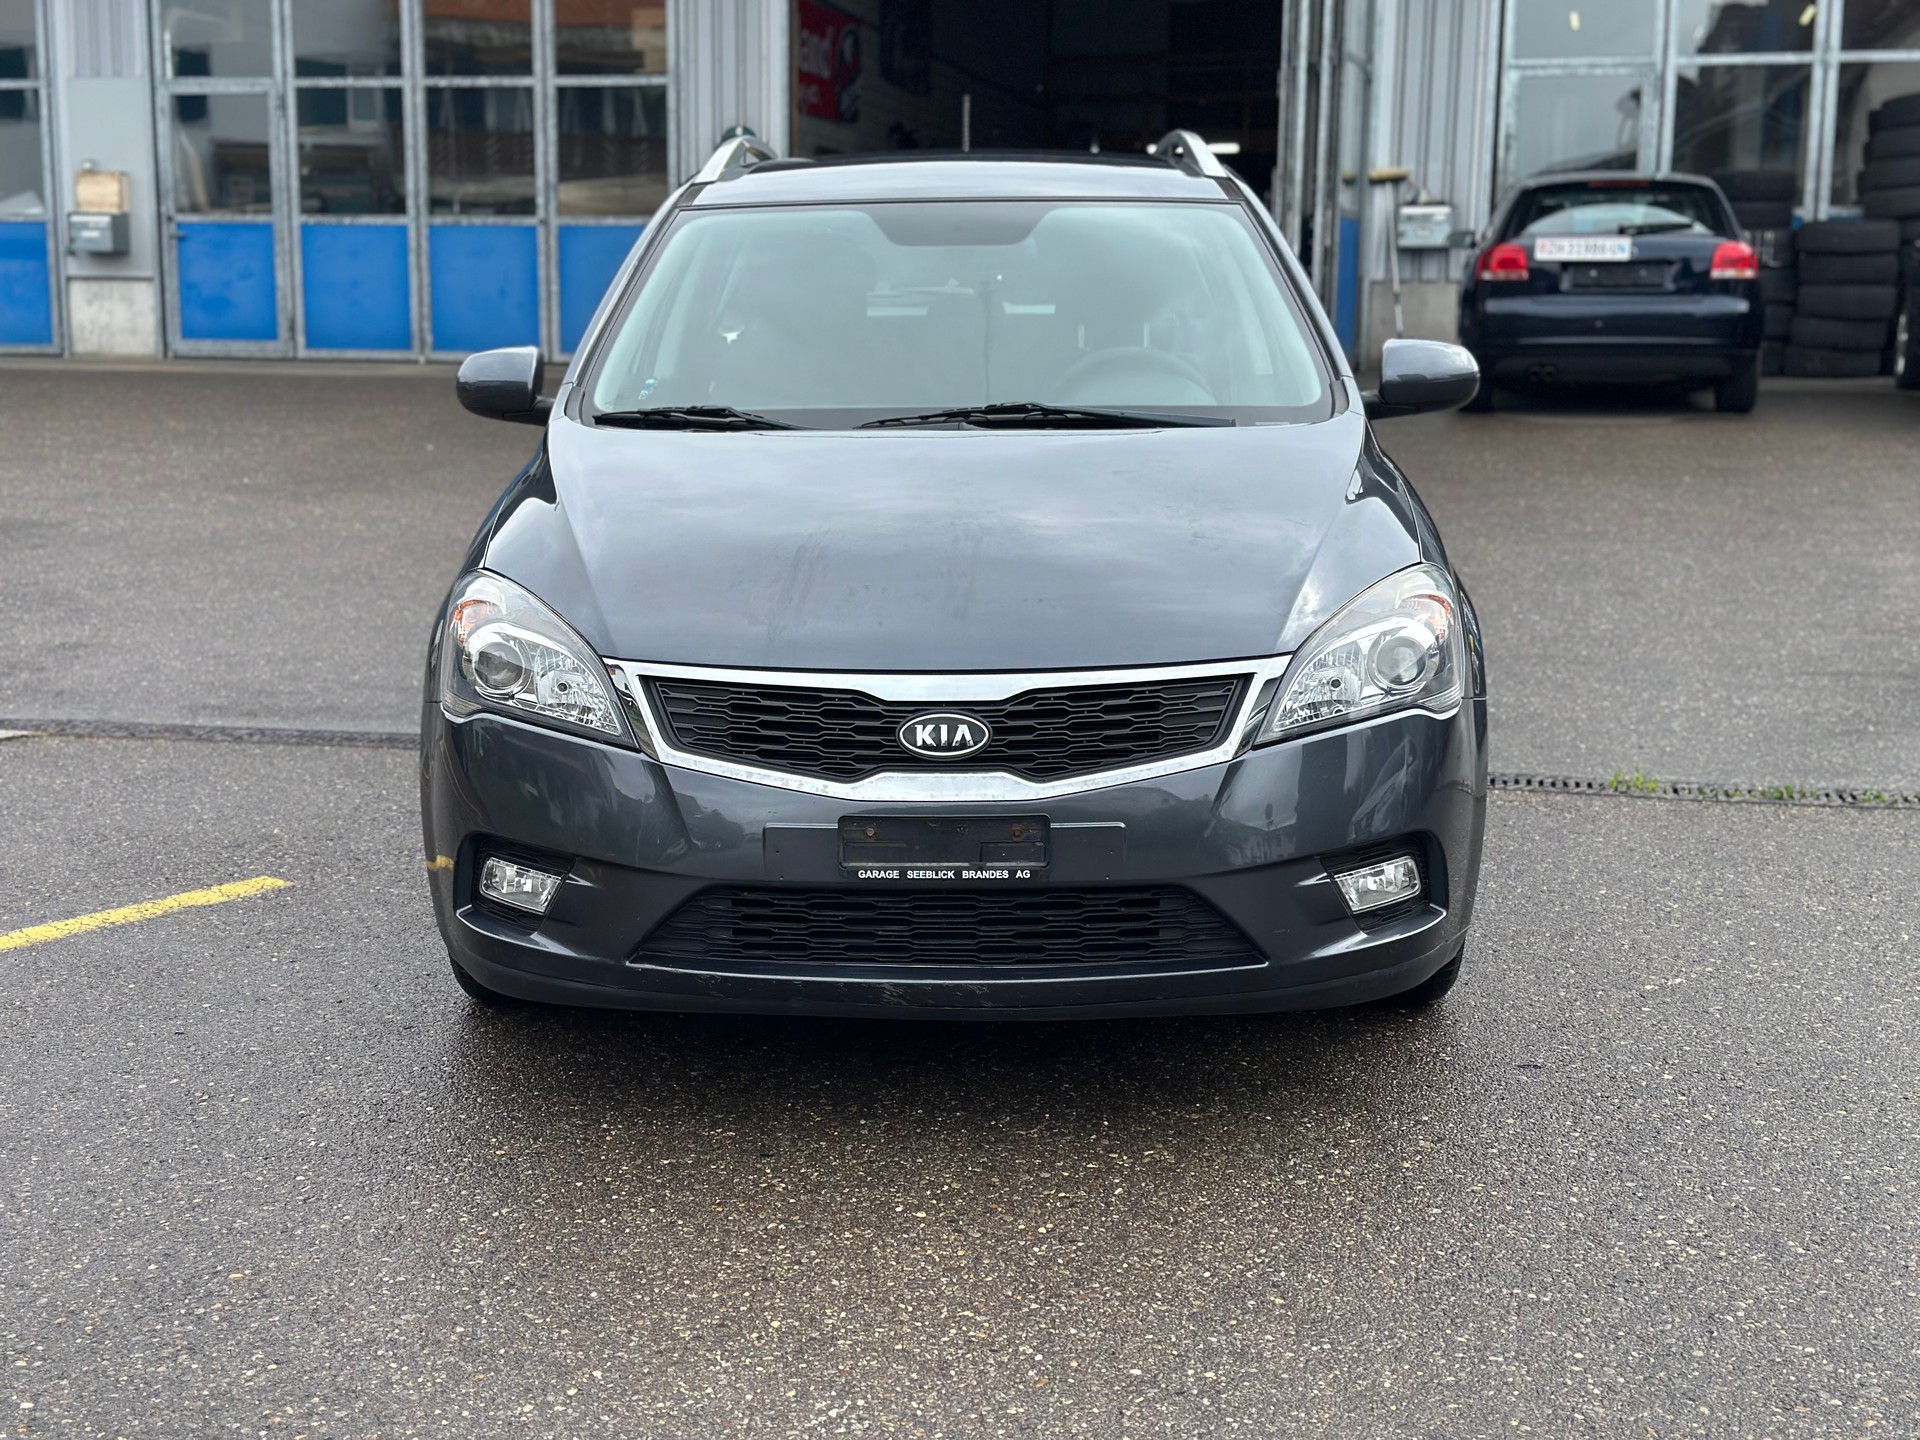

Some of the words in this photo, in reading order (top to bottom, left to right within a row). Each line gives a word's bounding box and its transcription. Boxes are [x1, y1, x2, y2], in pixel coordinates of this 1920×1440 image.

[914, 724, 975, 747] KIA
[858, 870, 900, 879] GARAGE
[906, 870, 955, 879] SEEBLICK
[962, 870, 1009, 879] BRANDES
[1015, 870, 1031, 879] AG
